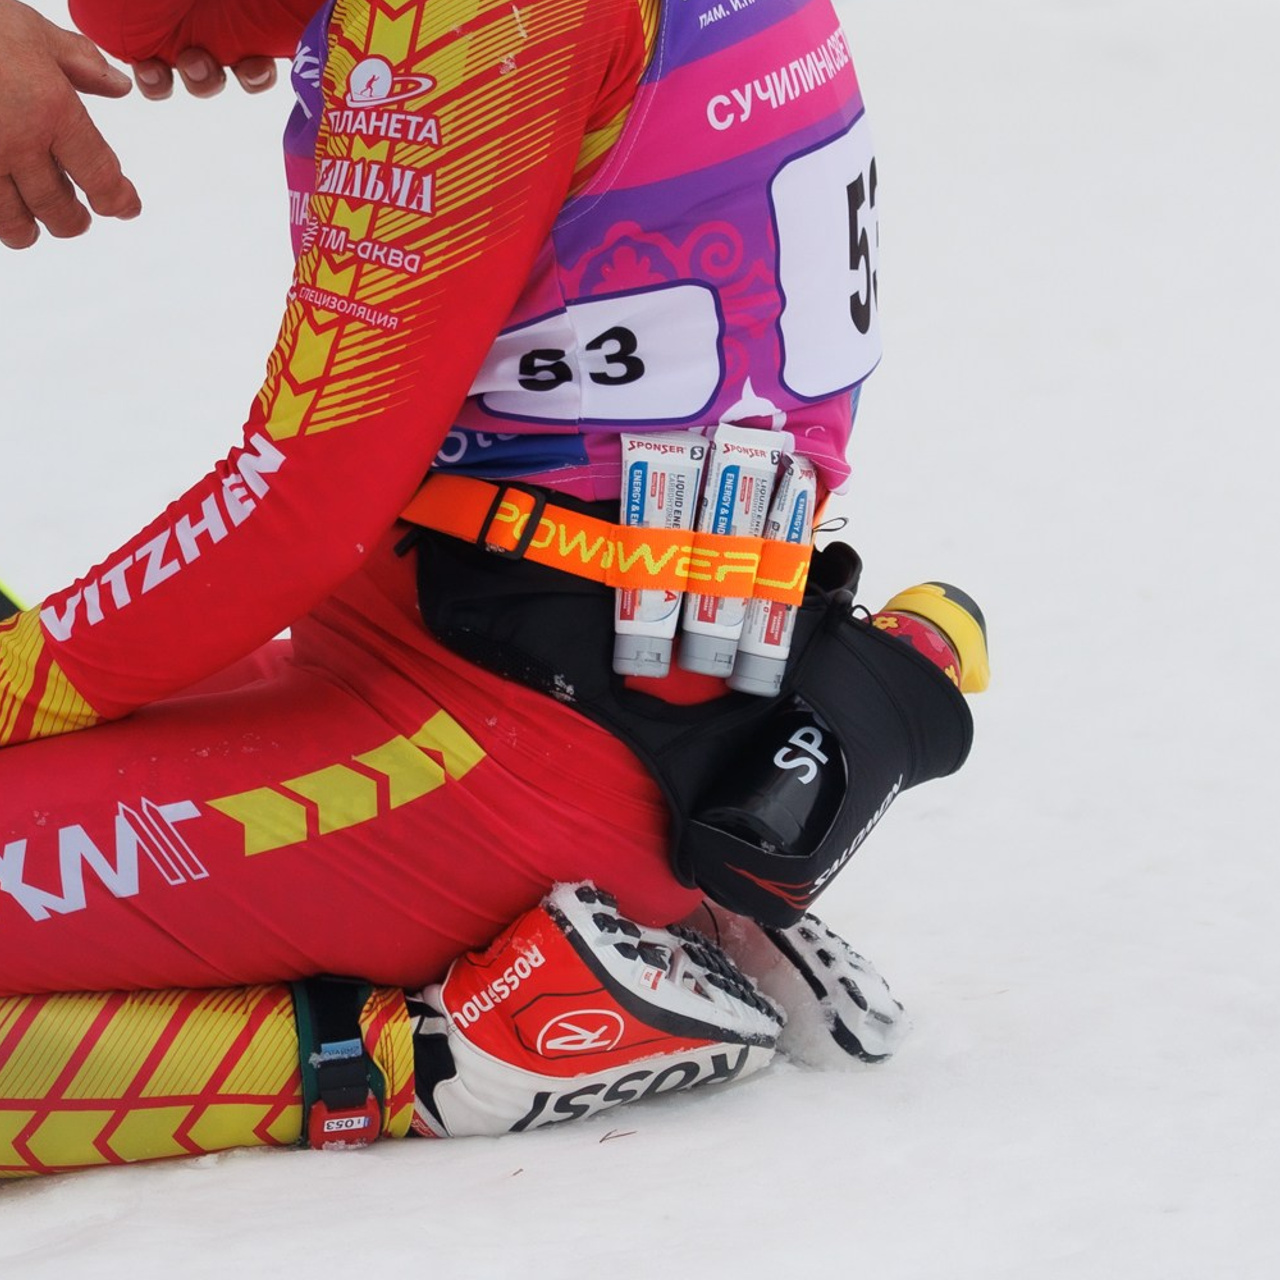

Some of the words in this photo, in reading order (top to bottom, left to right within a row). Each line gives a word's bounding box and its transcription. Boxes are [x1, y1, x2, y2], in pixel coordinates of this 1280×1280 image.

[706, 42, 836, 131] СУЧИЛИНА
[328, 109, 439, 145] ПЛАНЕТА
[299, 287, 399, 330] СПЕЦИЗОЛЯЦИЯ
[518, 326, 645, 392] 53
[628, 440, 685, 455] SPONSER
[723, 443, 766, 458] SPONSER
[631, 469, 642, 503] ENERGY
[675, 474, 685, 508] LIQUID
[722, 472, 735, 510] ENERGY
[758, 479, 767, 513] LIQUID
[40, 432, 287, 642] VITZHEN
[773, 726, 829, 784] SP
